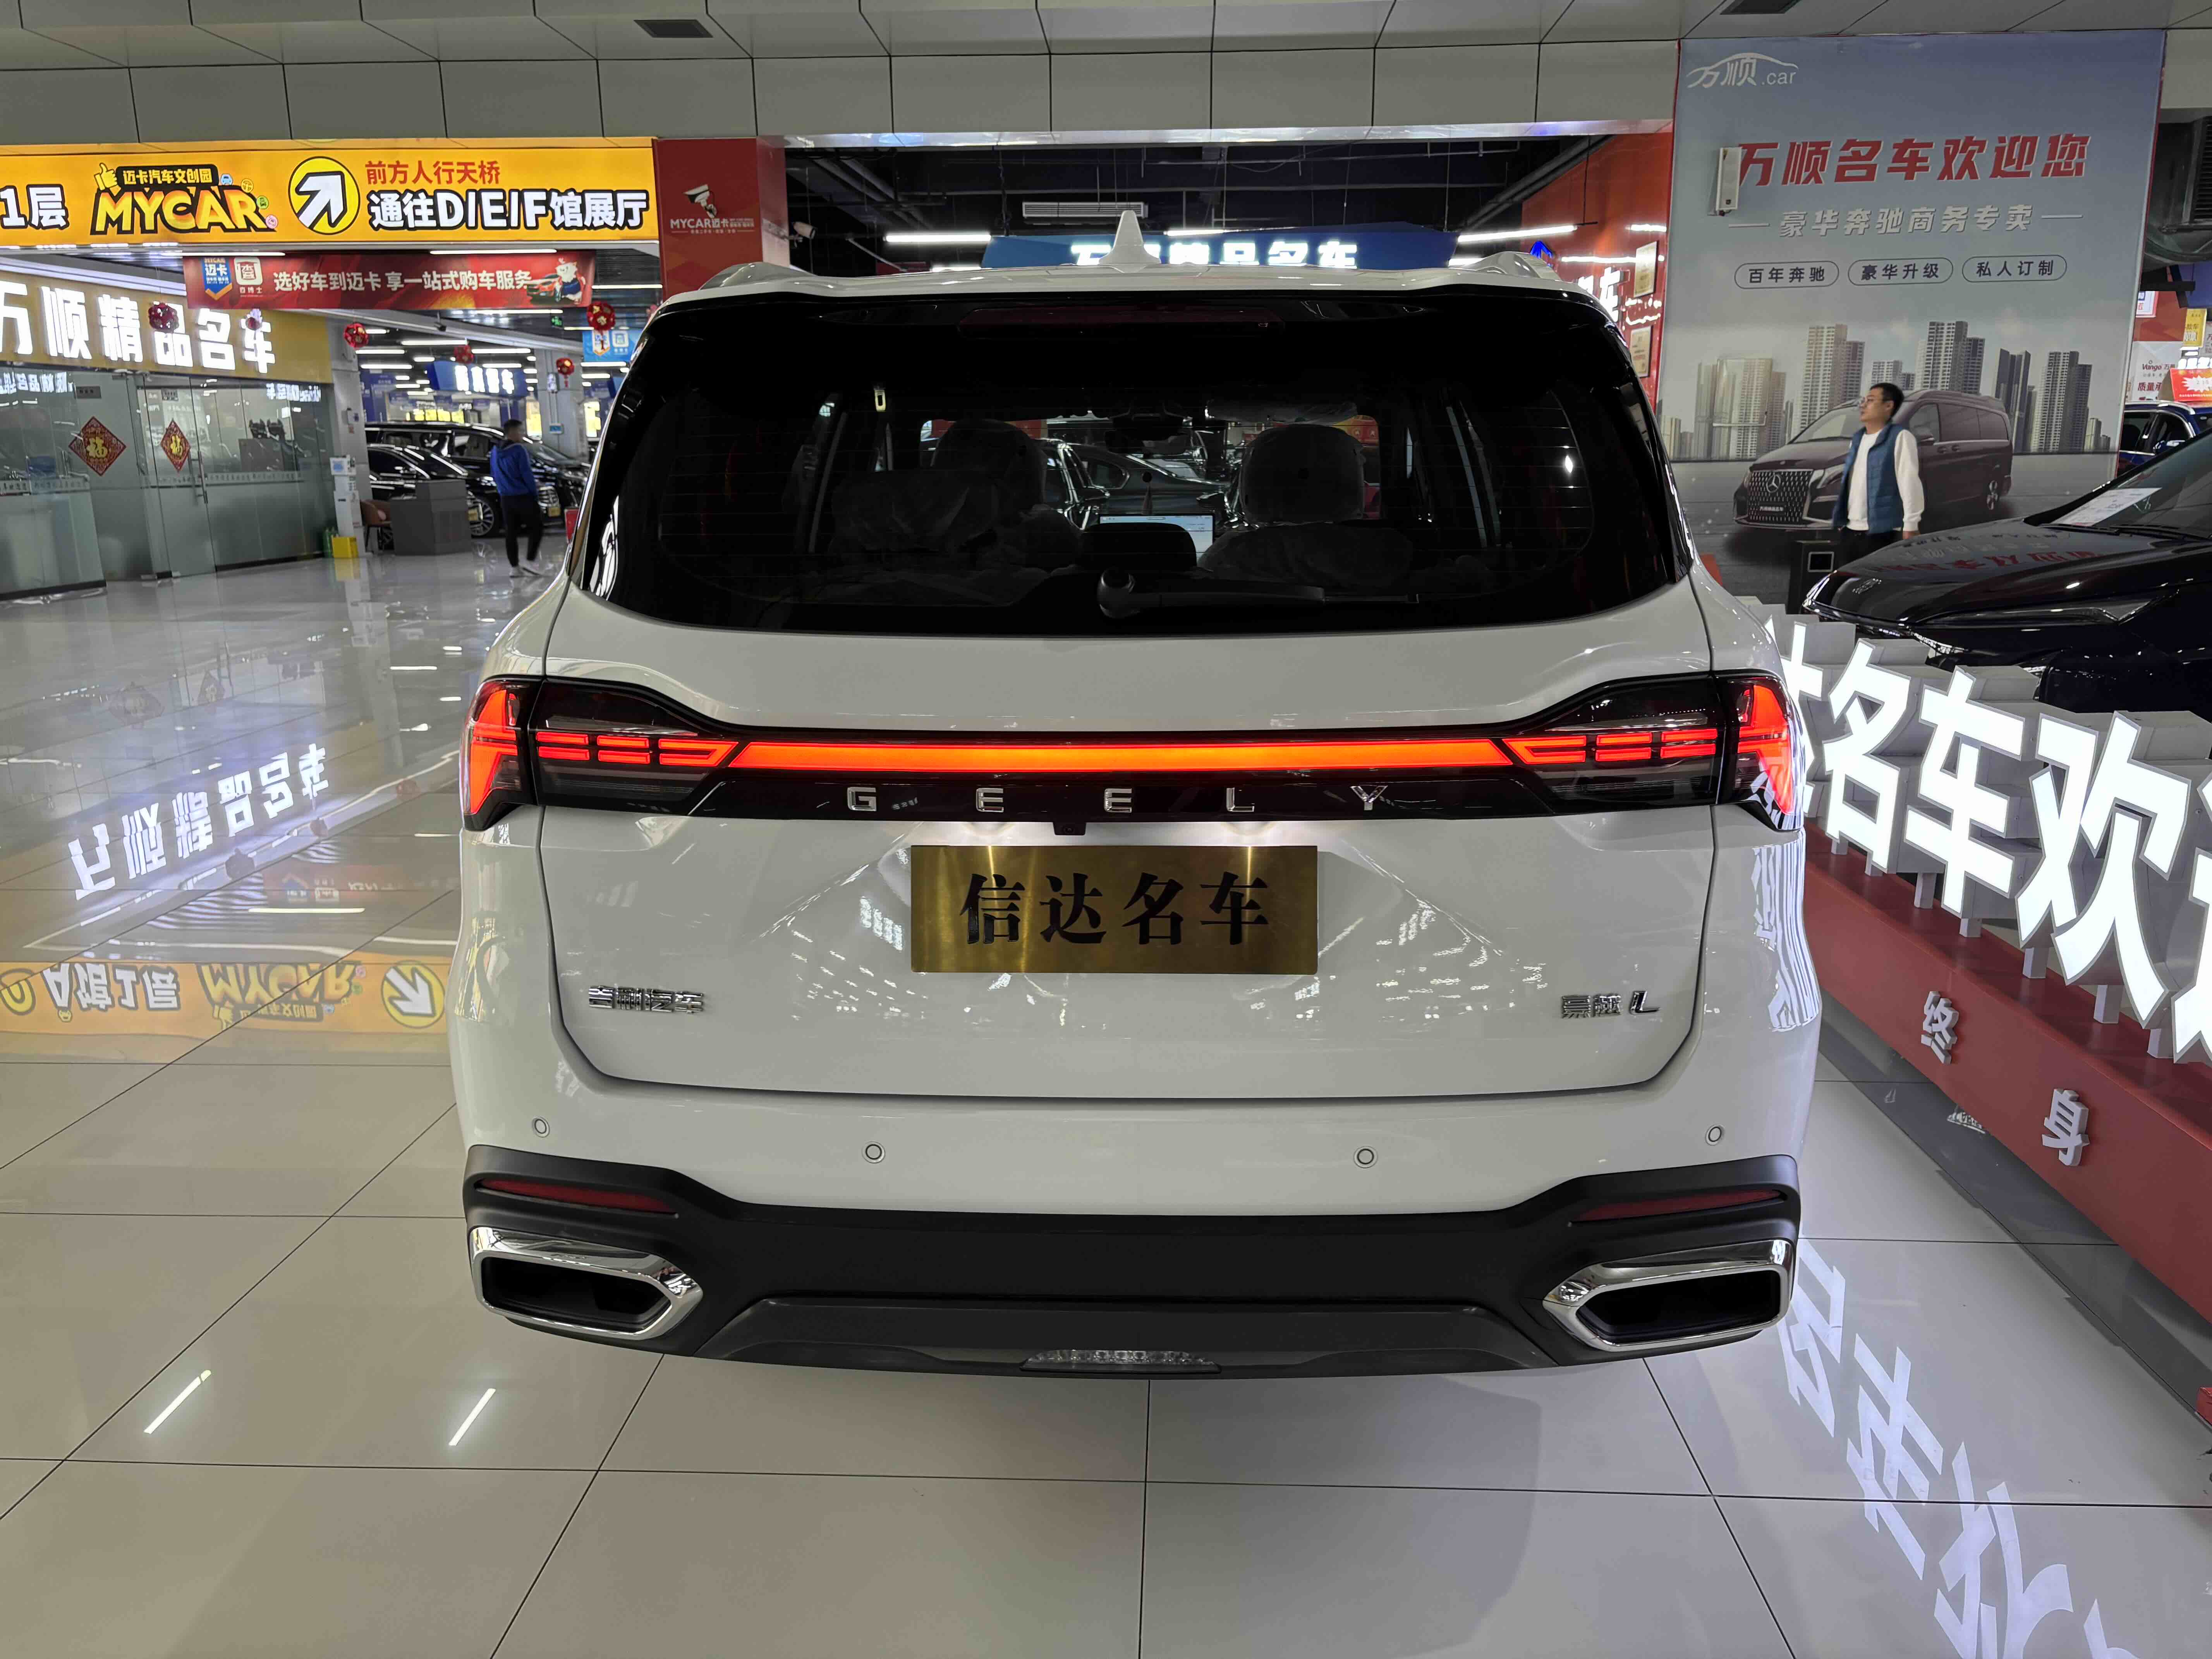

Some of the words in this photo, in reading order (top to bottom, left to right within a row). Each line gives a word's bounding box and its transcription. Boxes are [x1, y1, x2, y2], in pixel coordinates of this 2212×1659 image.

[1687, 57, 1757, 88] 万顺
[1761, 71, 1797, 86] .car
[365, 160, 500, 185] 前方人行天桥
[1739, 133, 2091, 187] 万顺名车欢迎您
[123, 168, 212, 185] 迈卡汽车文创园
[0, 185, 67, 229] 1层
[93, 187, 272, 233] MYCAR
[1779, 204, 2033, 238] 豪华奔驰商务专卖
[205, 264, 228, 276] 迈卡
[273, 271, 382, 292] 选好车到迈卡
[387, 270, 532, 292] 享一站式购车服务
[1748, 266, 1826, 283] 百年奔驰
[1861, 263, 1939, 281] 豪华升级
[1976, 259, 2054, 277] 私人订制
[846, 785, 1389, 812] GEELY
[960, 871, 1270, 945] 信达名车
